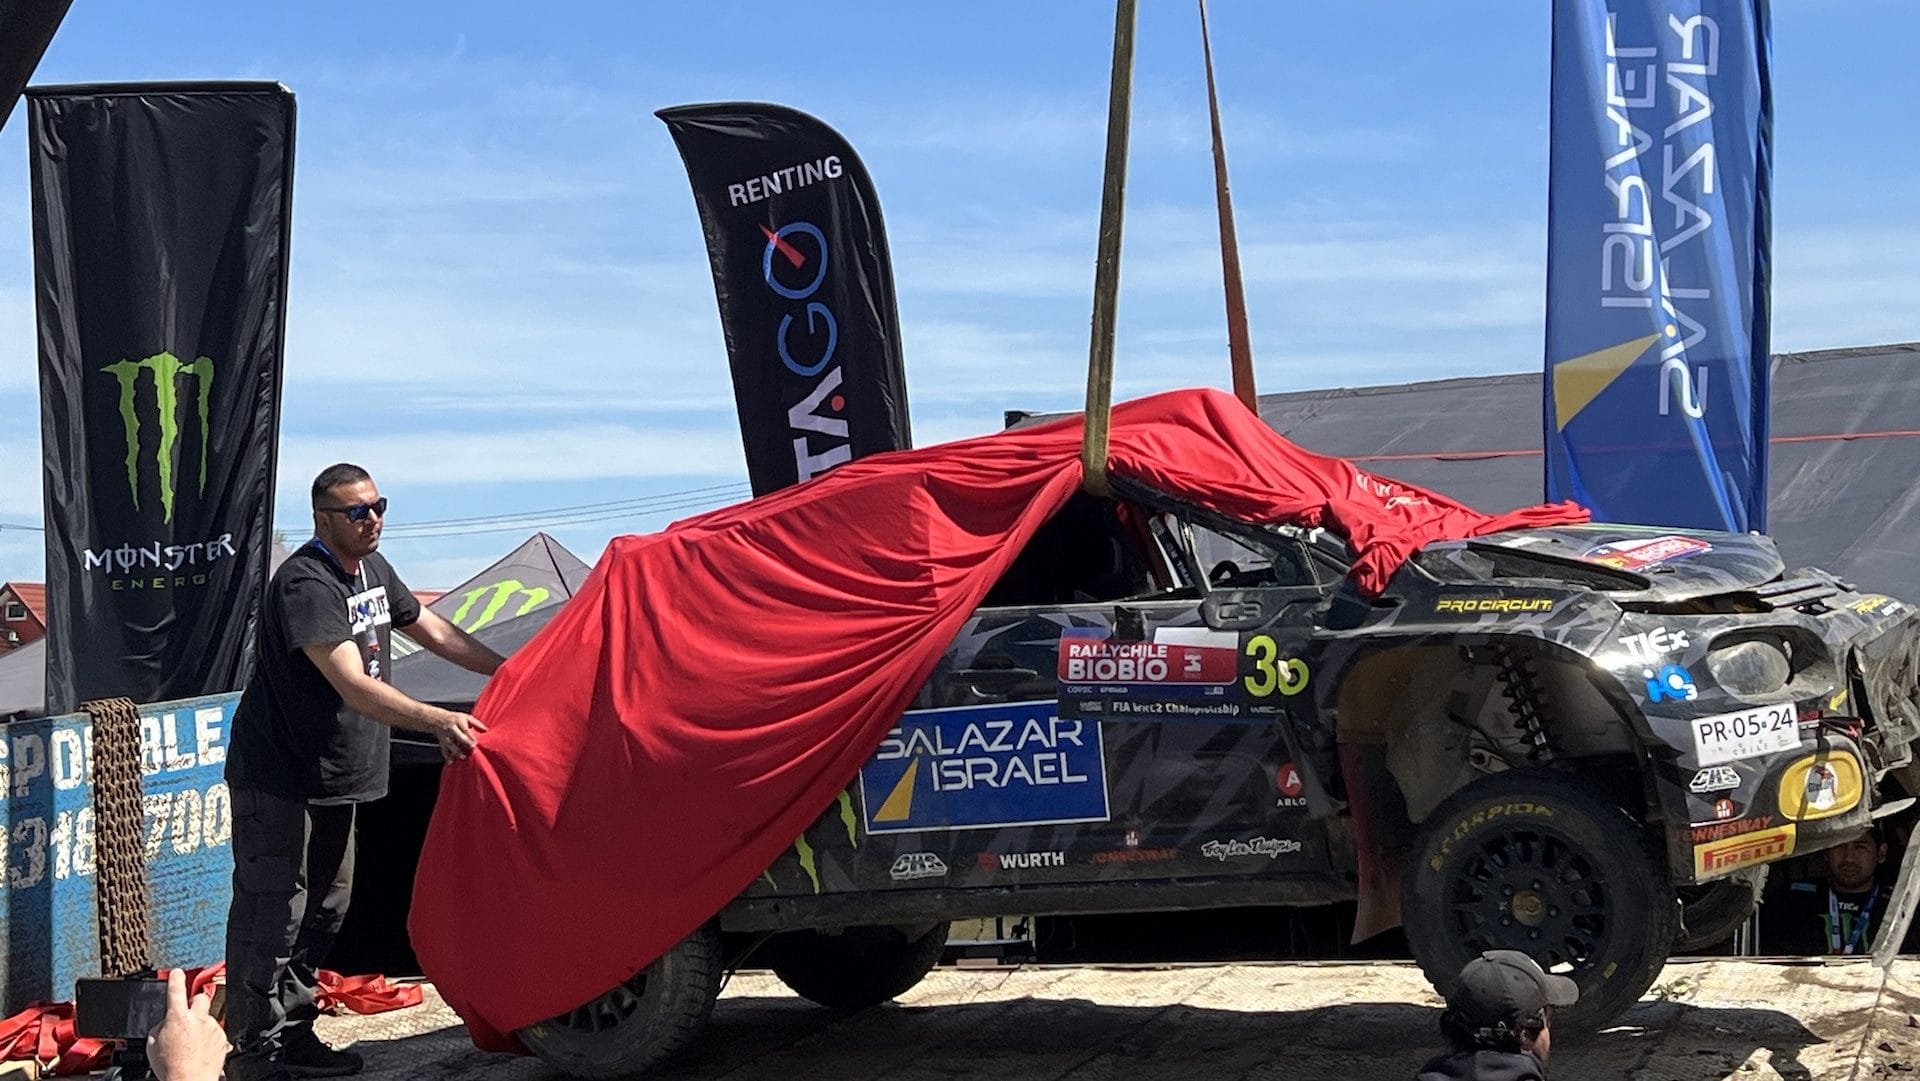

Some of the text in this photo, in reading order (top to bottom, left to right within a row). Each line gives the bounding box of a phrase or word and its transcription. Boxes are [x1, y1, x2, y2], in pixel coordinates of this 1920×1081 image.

[728, 155, 843, 208] RENTING
[112, 574, 212, 590] ENERG
[1436, 599, 1553, 613] PRO CIRCUIT
[1113, 701, 1131, 712] FIA
[876, 716, 1084, 760] SALAZAR
[931, 752, 1088, 792] ISRAEL
[1429, 802, 1553, 872] SCORPION
[1703, 833, 1787, 872] PIRELLI
